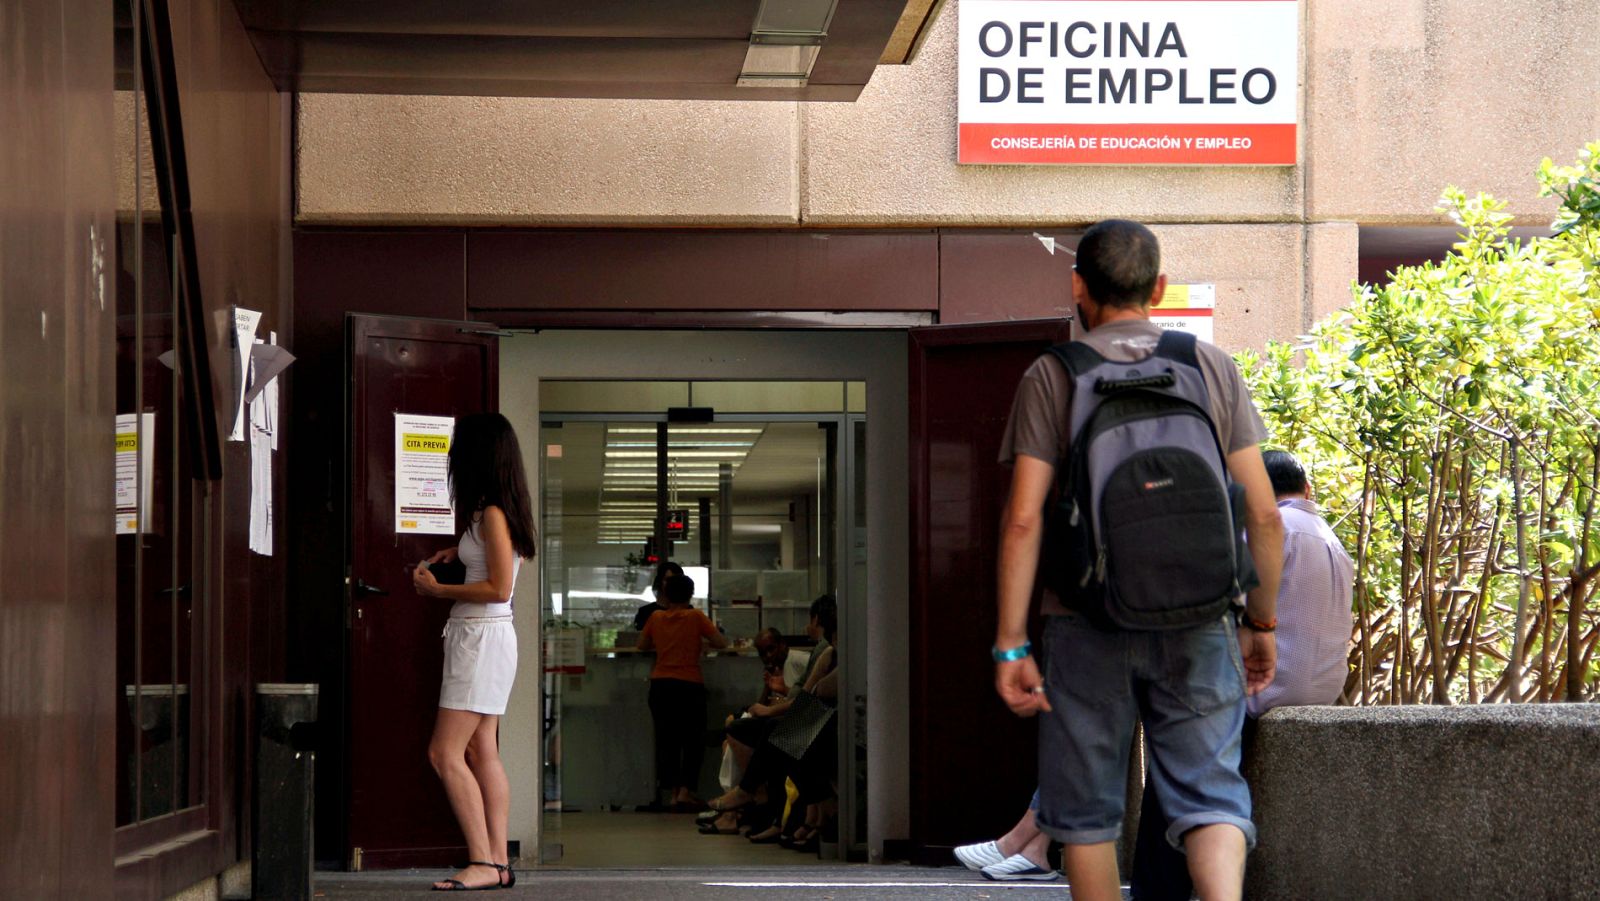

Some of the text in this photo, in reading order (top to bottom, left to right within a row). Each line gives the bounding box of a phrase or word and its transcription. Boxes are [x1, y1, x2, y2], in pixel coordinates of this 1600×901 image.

[979, 21, 1188, 58] OFICINA
[979, 67, 1277, 105] DE EMPLEO
[990, 135, 1252, 150] CONSEJERÍA DE EDUCACIÓN Y EMPLEO
[406, 440, 447, 449] CITA PREVIA
